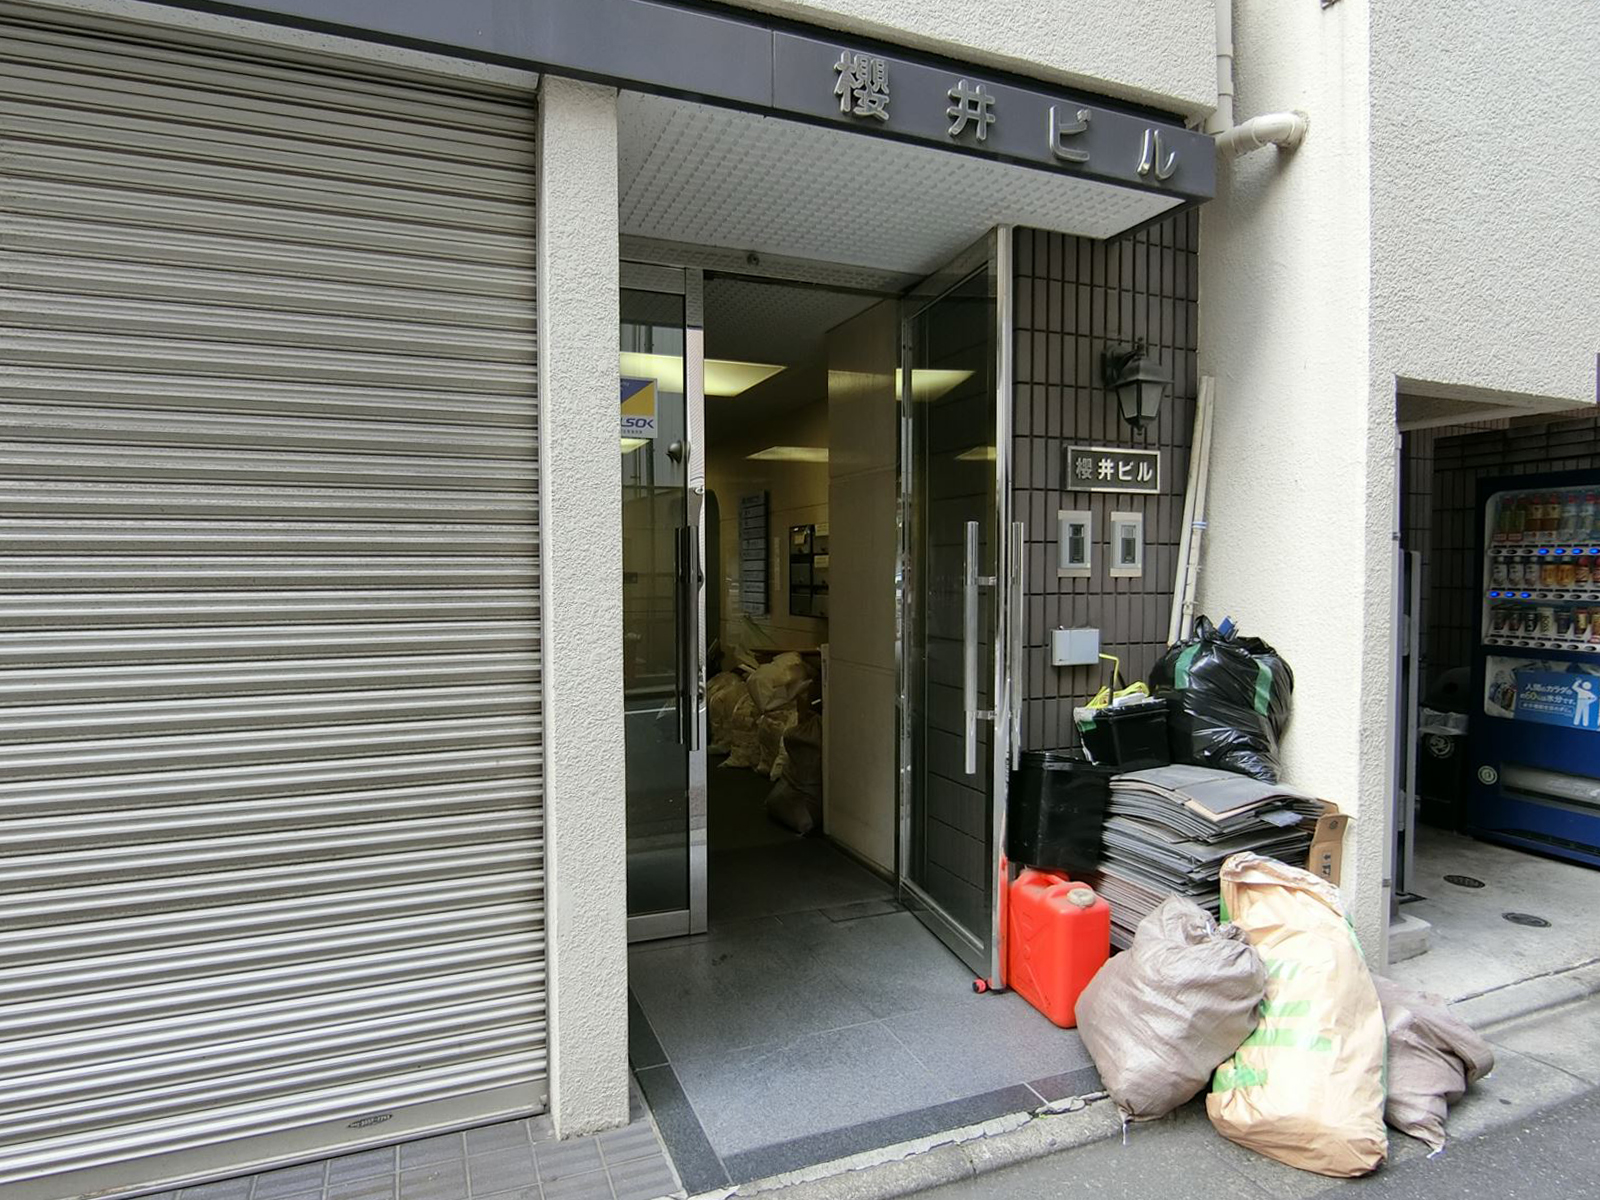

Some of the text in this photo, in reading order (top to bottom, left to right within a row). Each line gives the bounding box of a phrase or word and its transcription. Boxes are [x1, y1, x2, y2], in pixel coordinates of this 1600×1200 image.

[834, 50, 1176, 181] 櫻井ビル
[1076, 457, 1153, 482] 櫻井ビル
